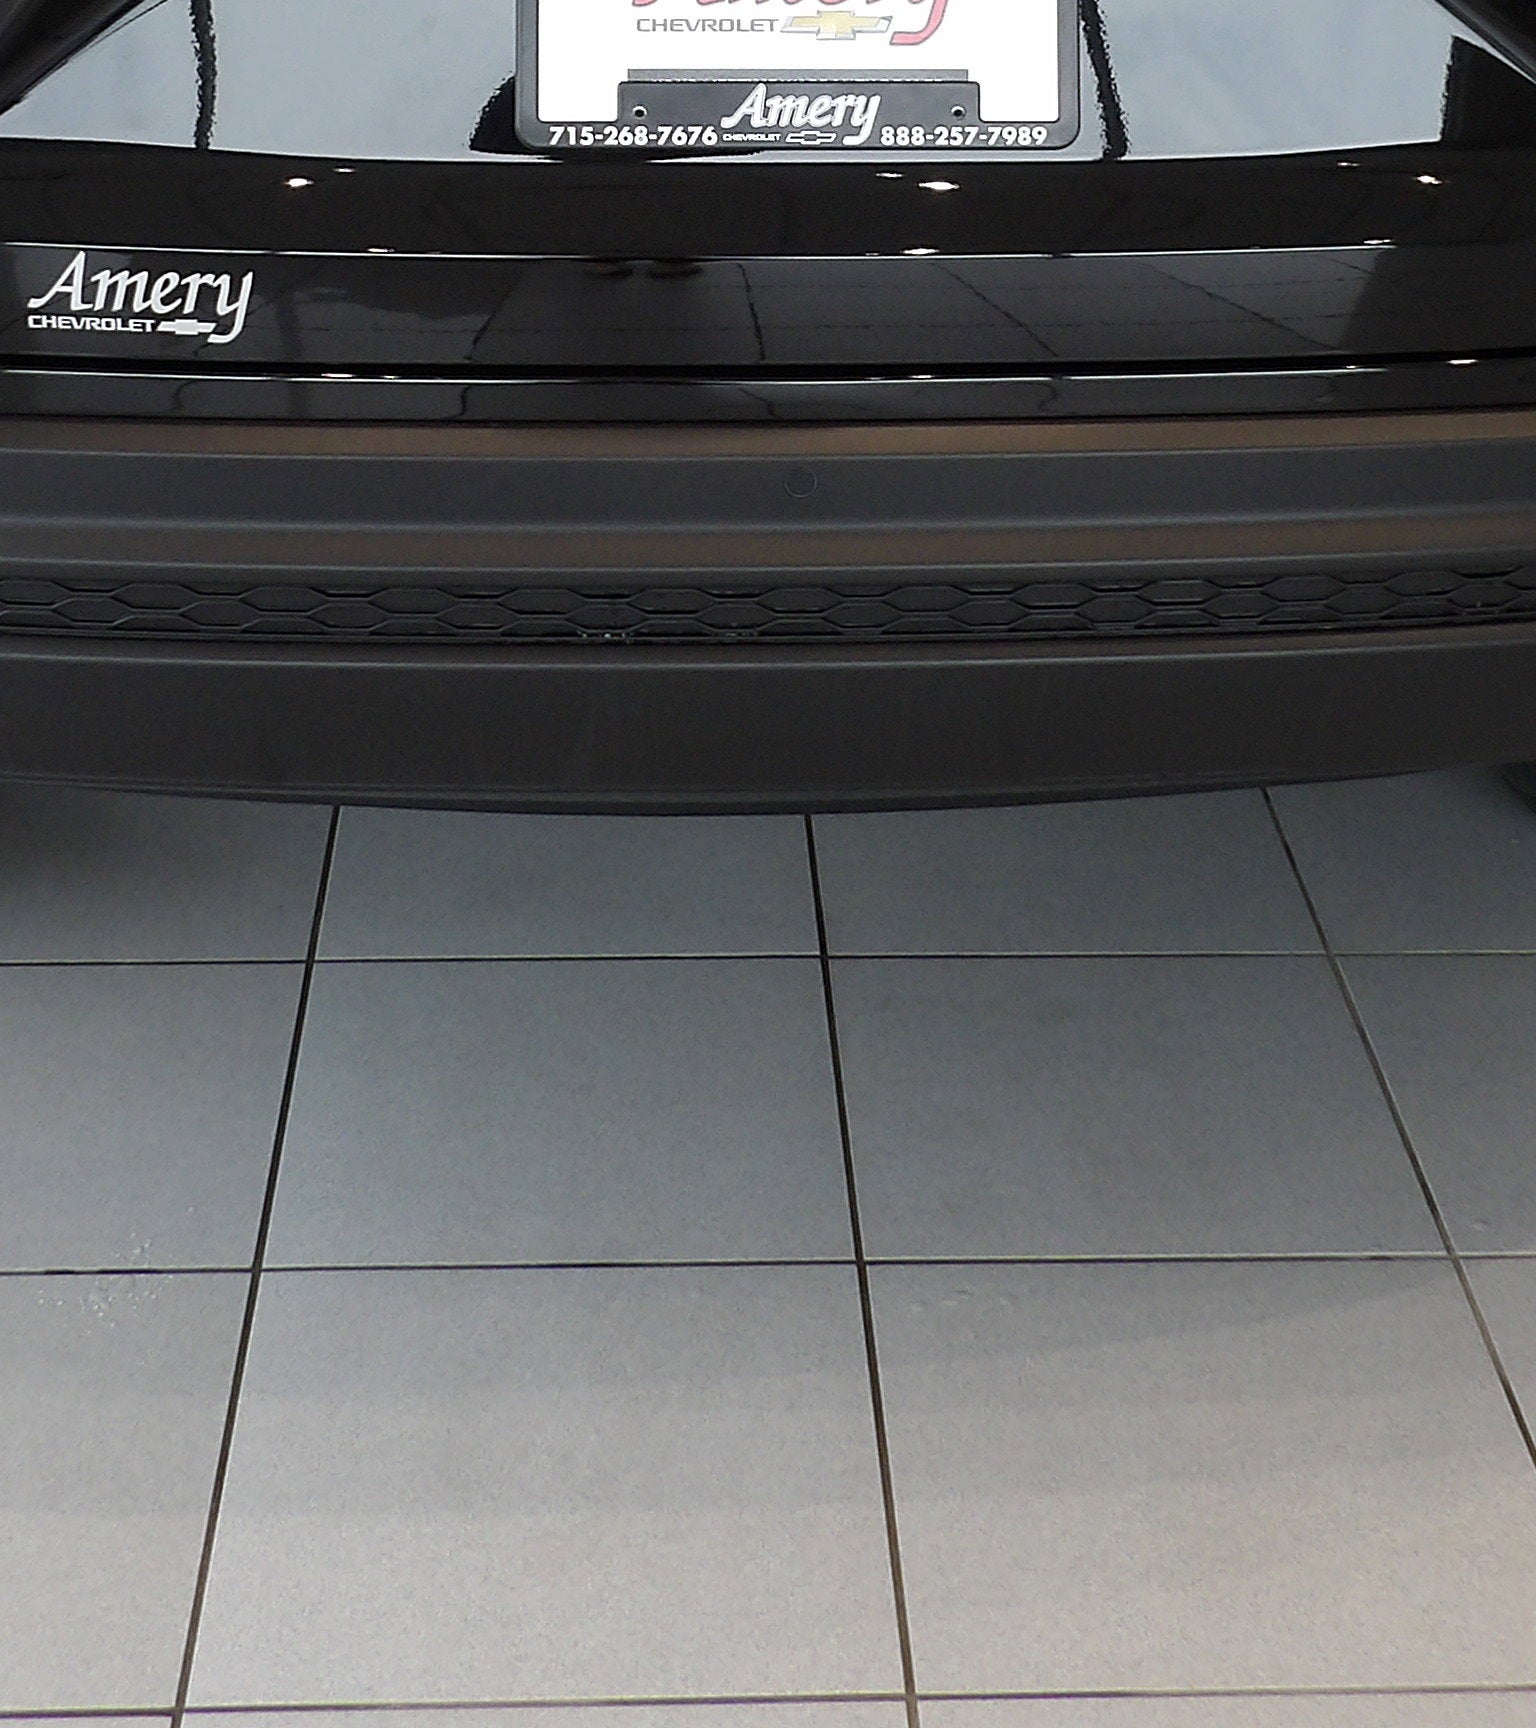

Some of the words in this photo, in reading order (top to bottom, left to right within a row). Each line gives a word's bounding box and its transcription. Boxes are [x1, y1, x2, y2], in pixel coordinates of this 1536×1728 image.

[636, 17, 779, 33] CHEVROLET
[720, 83, 881, 145] Amery
[549, 126, 718, 146] 715-268-7676
[722, 133, 782, 142] CHEVROLET
[880, 126, 1048, 146] 888-257-7989
[27, 250, 253, 344] Amery
[27, 315, 156, 334] CHEVROLET
